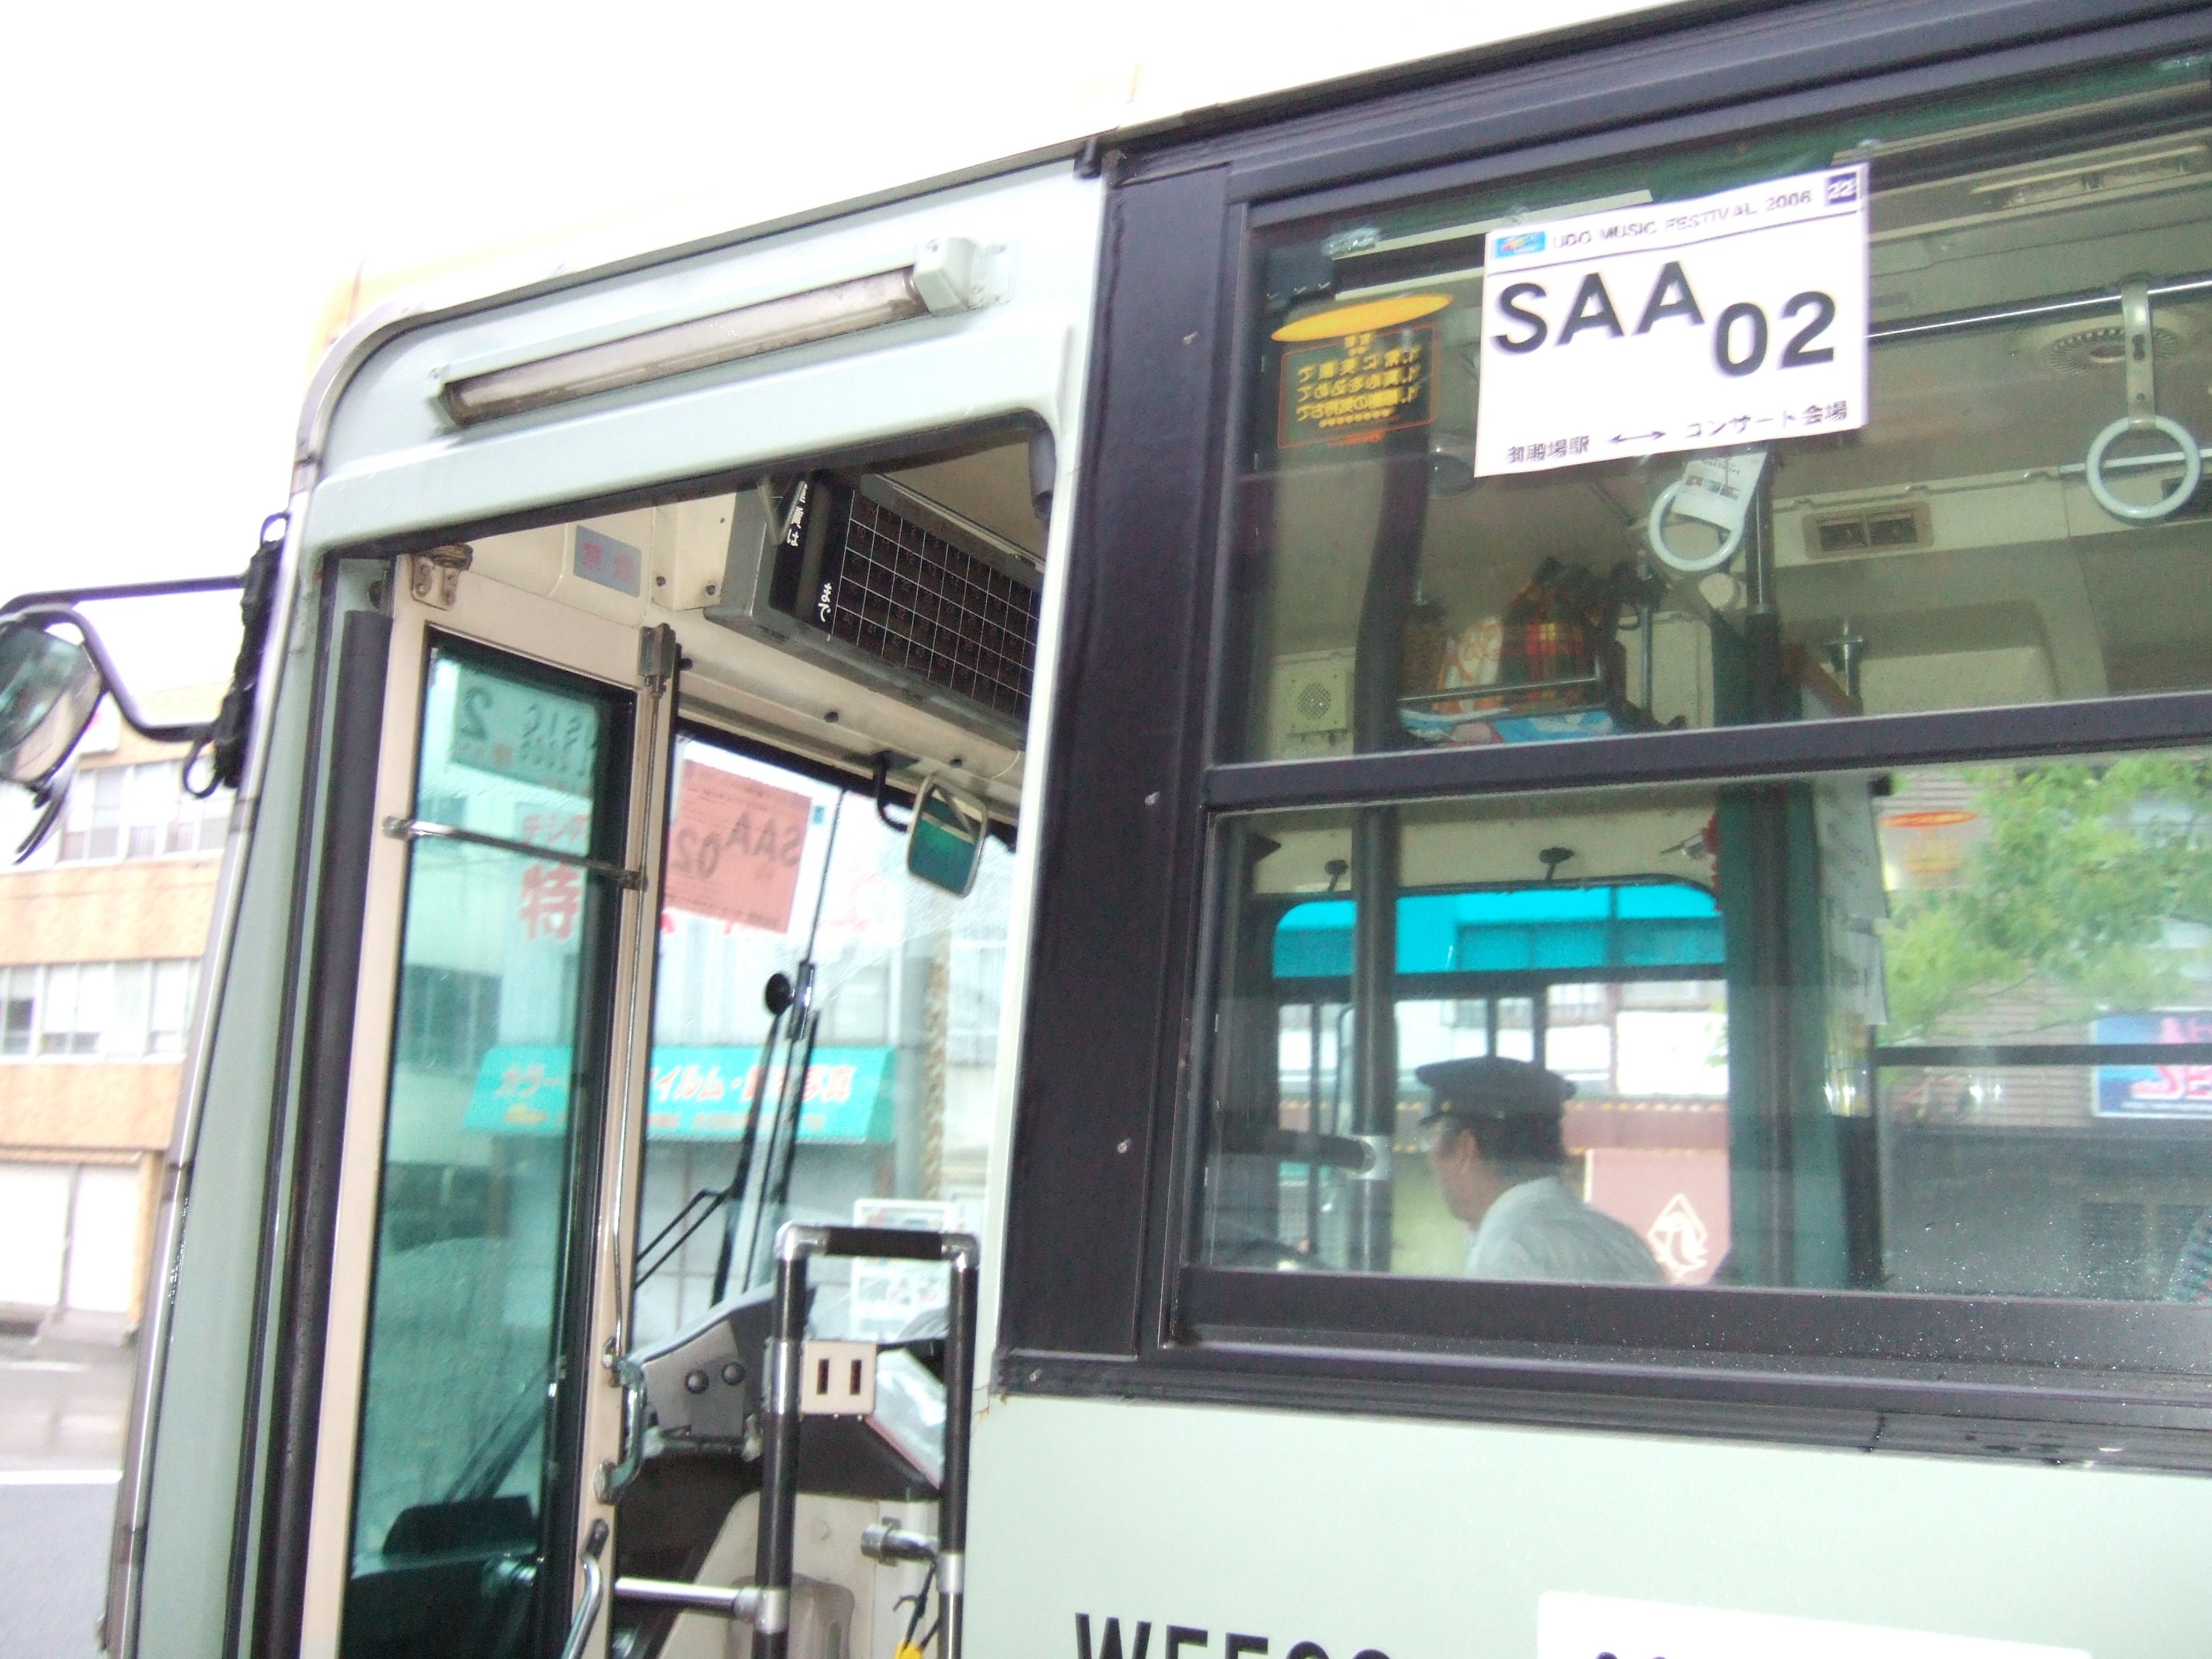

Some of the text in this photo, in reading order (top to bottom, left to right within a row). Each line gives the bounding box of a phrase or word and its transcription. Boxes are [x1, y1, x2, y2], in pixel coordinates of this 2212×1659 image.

[1553, 231, 1592, 250] UDO
[1599, 221, 1658, 242] MUSIC
[1664, 203, 1758, 232] FESTIVAL
[1765, 190, 1813, 211] 2006
[1505, 401, 1849, 464] 御殿場駅 コンサート会場
